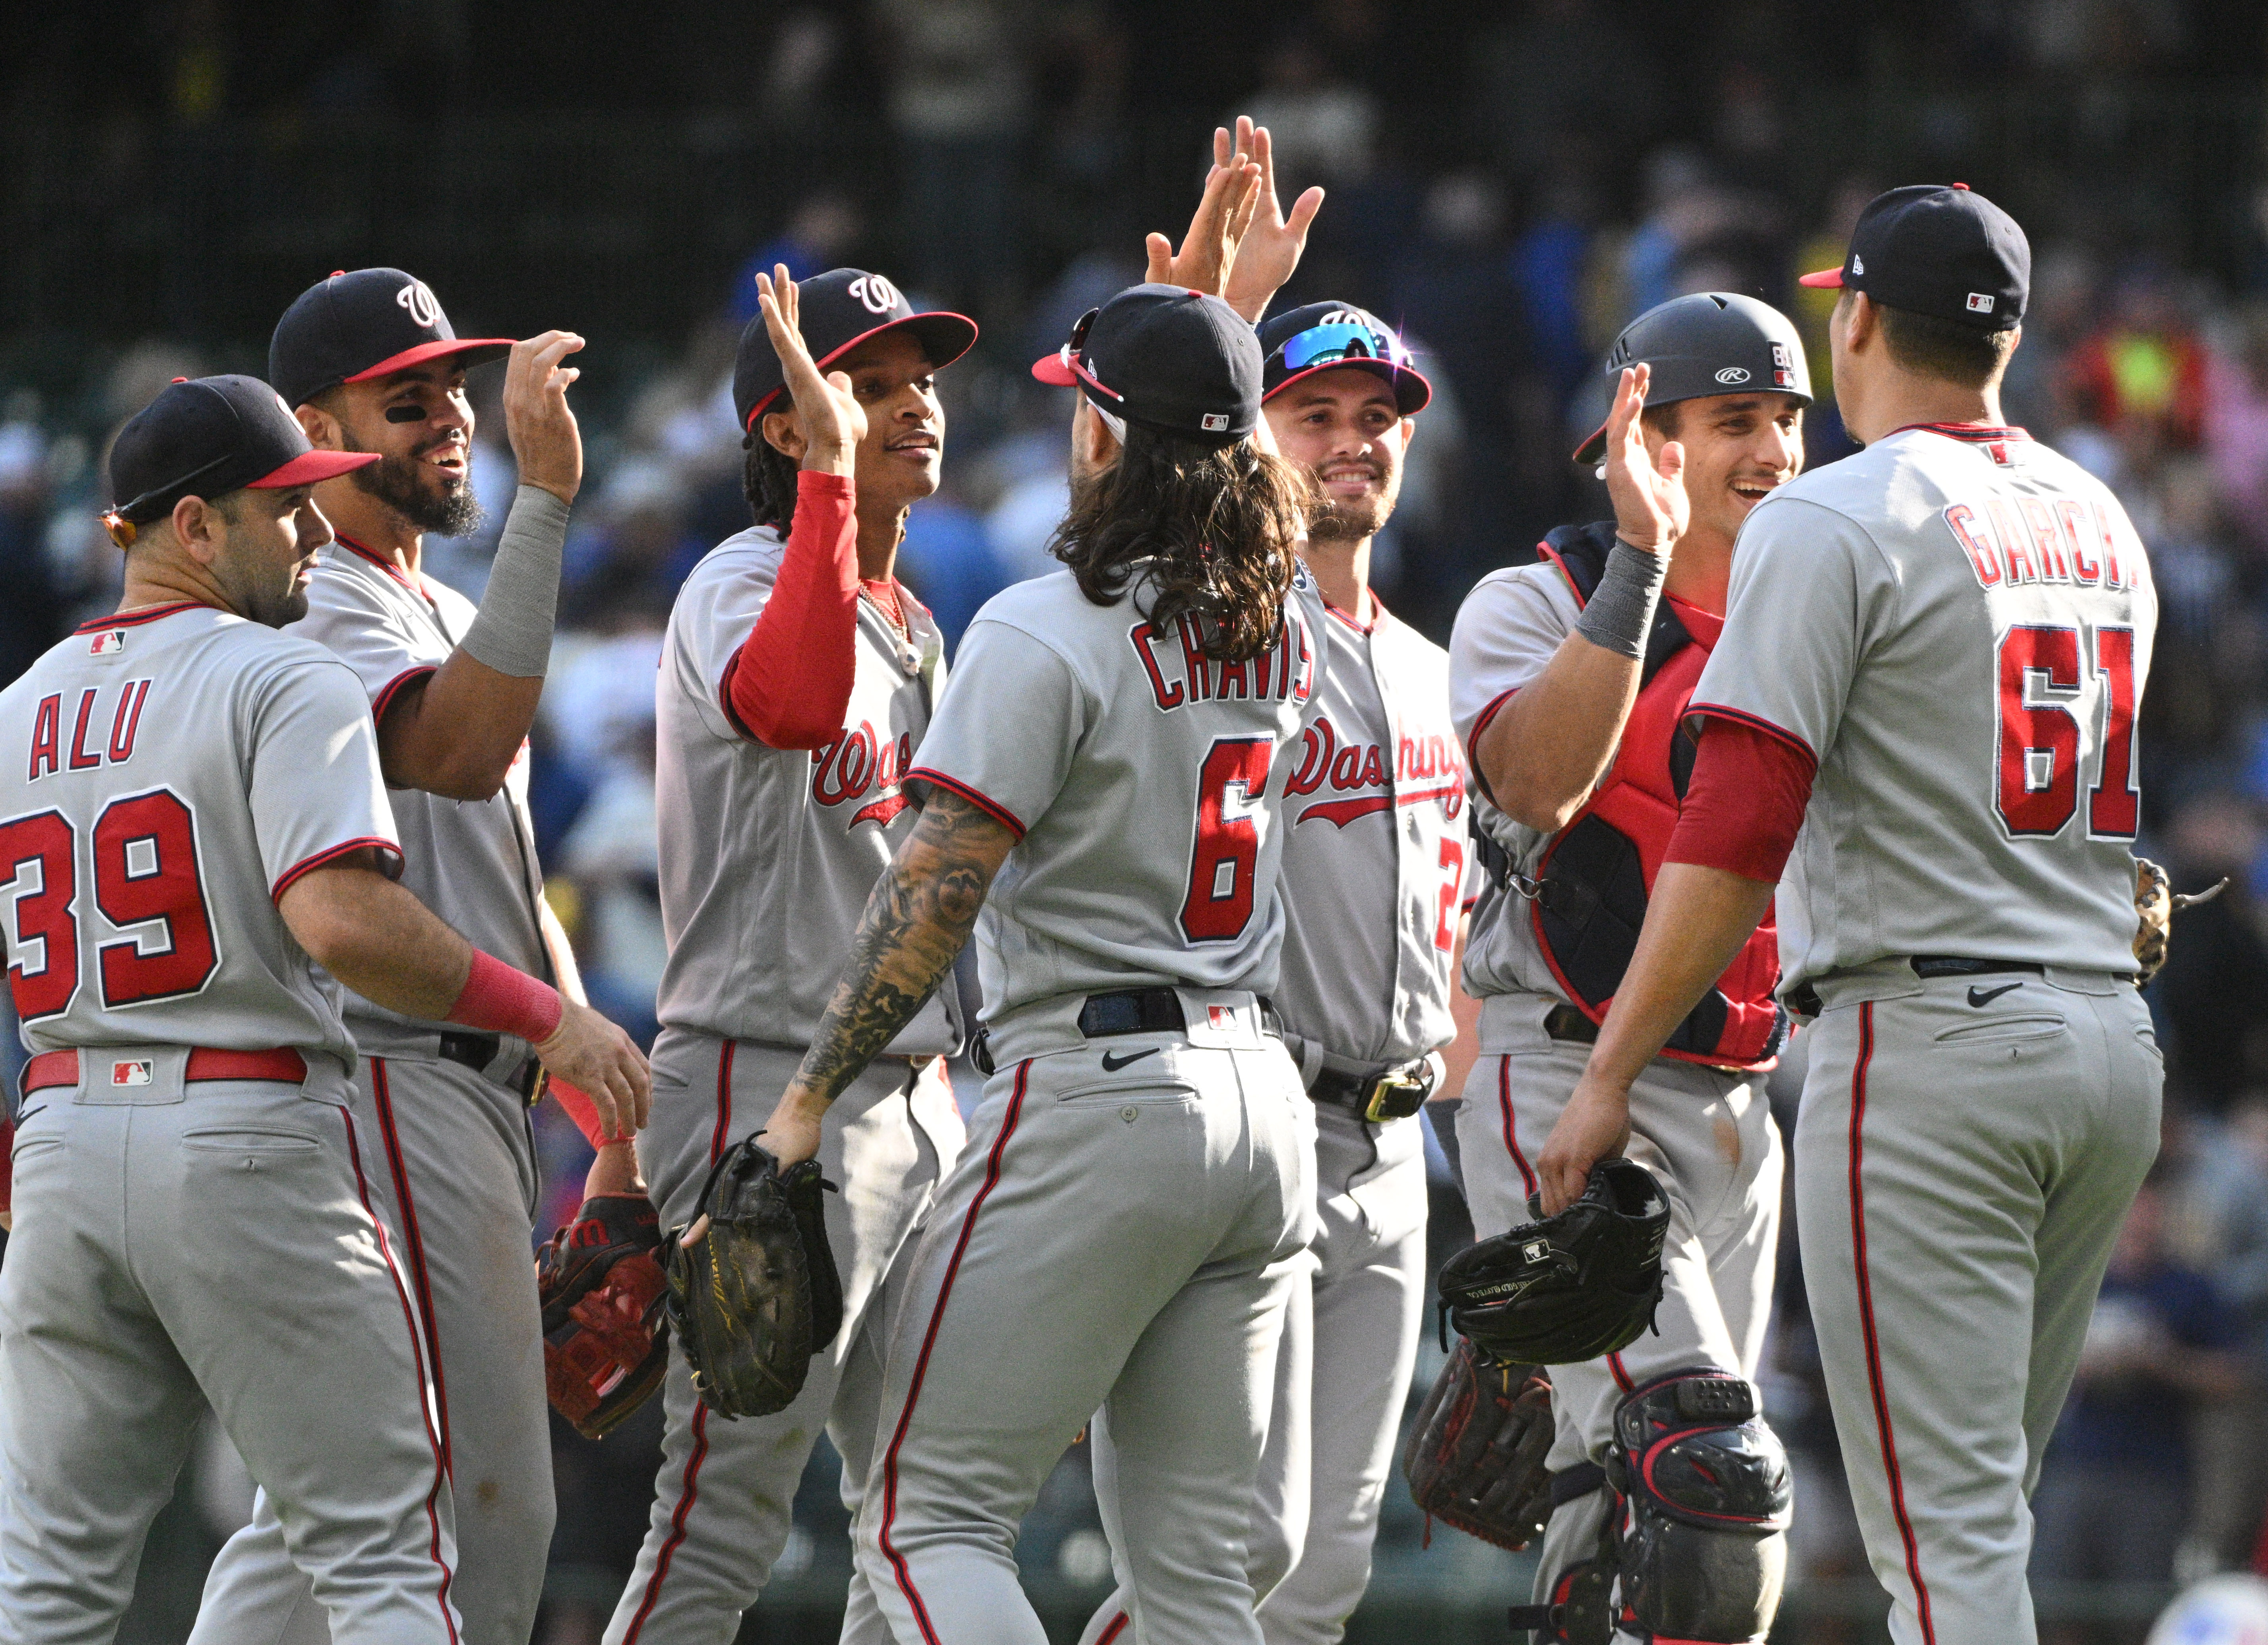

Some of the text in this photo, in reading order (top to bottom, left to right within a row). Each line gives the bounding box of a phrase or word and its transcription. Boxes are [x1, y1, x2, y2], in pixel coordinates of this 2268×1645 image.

[397, 281, 441, 328] W
[848, 275, 898, 315] W
[1719, 368, 1744, 382] R
[27, 677, 154, 784] ALU
[1991, 621, 2140, 843] 61
[1175, 730, 1277, 948] 6
[0, 783, 222, 1027] 39
[1434, 836, 1464, 954] 2
[1480, 1285, 1501, 1296] GLOVE
[1501, 1282, 1518, 1292] GOLD
